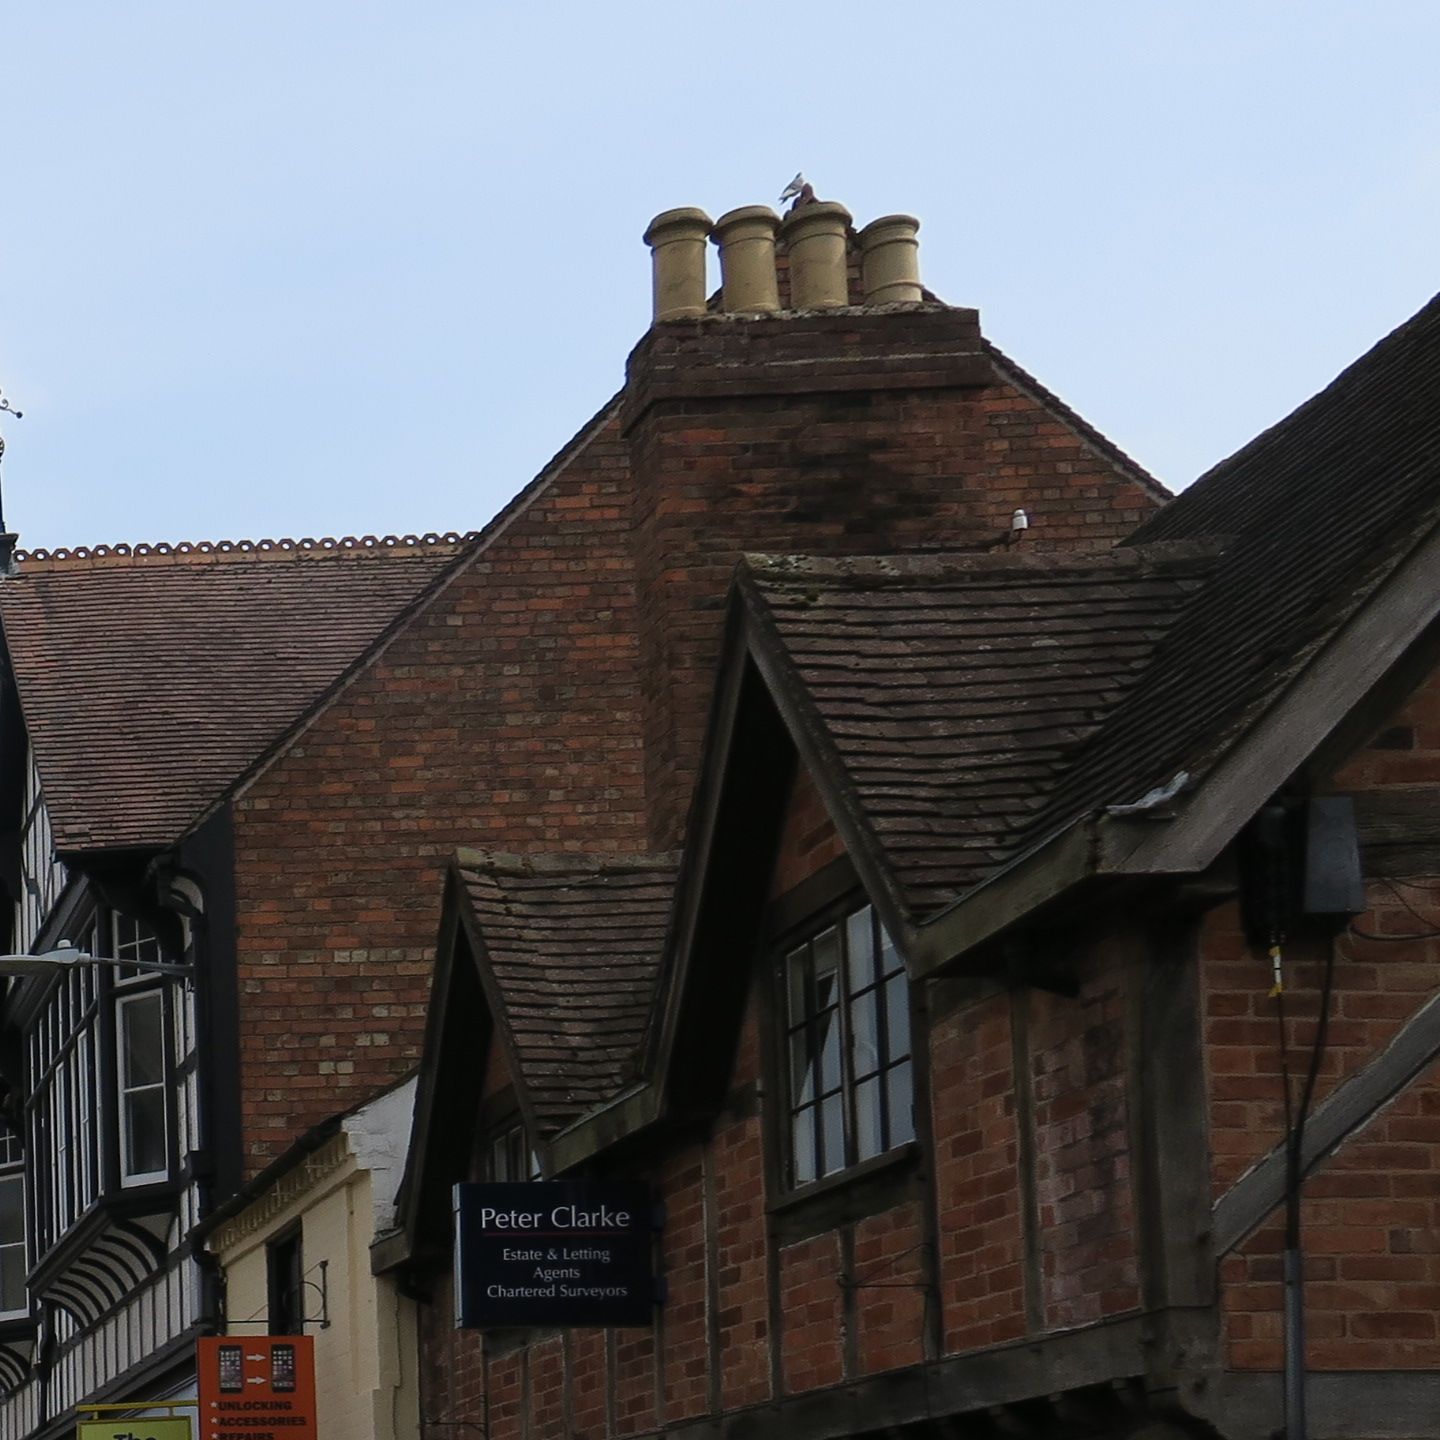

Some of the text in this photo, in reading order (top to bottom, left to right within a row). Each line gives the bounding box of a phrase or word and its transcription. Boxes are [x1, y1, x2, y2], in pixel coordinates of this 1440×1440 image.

[481, 1204, 631, 1229] Peter Clarke
[503, 1247, 610, 1263] Estate & Letting
[533, 1266, 581, 1281] Agents
[487, 1284, 628, 1300] Chartered Surveyors
[218, 1401, 292, 1410] UNLOCKING
[220, 1416, 307, 1426] ACCESSORIES
